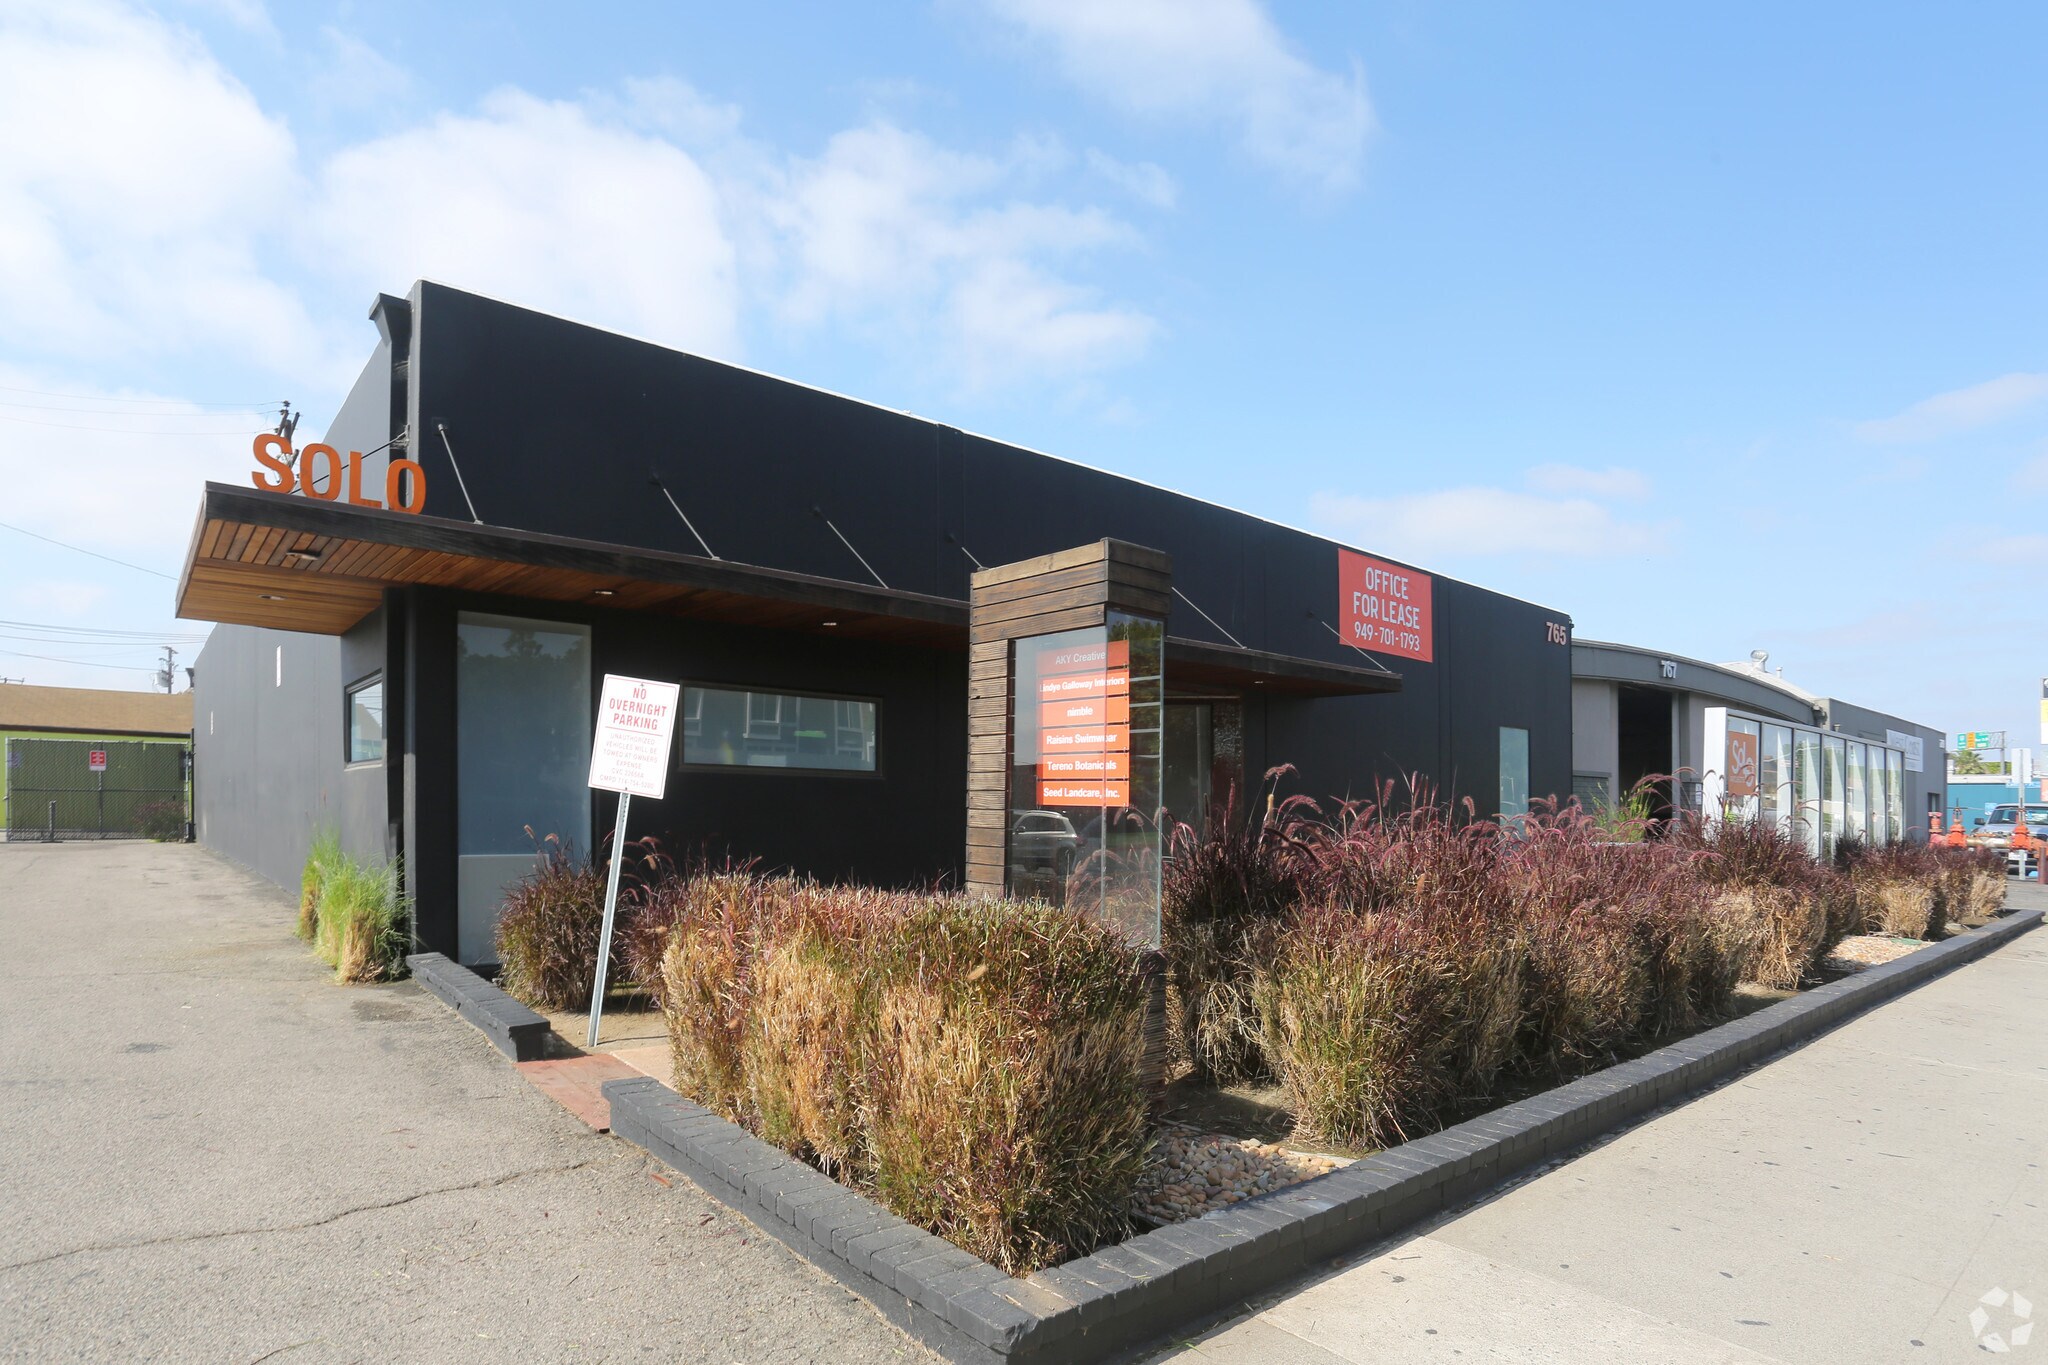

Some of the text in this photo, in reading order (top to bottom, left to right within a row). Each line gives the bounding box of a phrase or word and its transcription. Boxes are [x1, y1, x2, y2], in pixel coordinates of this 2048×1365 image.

[251, 433, 426, 515] SOLO
[1365, 566, 1408, 600] OFFICE
[1353, 591, 1420, 630] FOR LEASE
[1354, 621, 1420, 652] 949-701-1793
[1545, 621, 1567, 646] 765
[1073, 650, 1107, 663] Creative
[1661, 659, 1677, 679] 767
[1062, 680, 1093, 690] Galloway
[1094, 676, 1126, 687] Interiors
[633, 687, 647, 700] NO
[609, 697, 667, 717] OVERNIGHT
[1067, 706, 1093, 717] nimble
[613, 712, 658, 730] PARKING
[610, 732, 656, 746] UNAUTHORIZED
[1046, 735, 1073, 745] Raisins
[1047, 760, 1117, 771] Tereno Botanicals
[1043, 787, 1120, 799] Seed Landcare, Inc.
